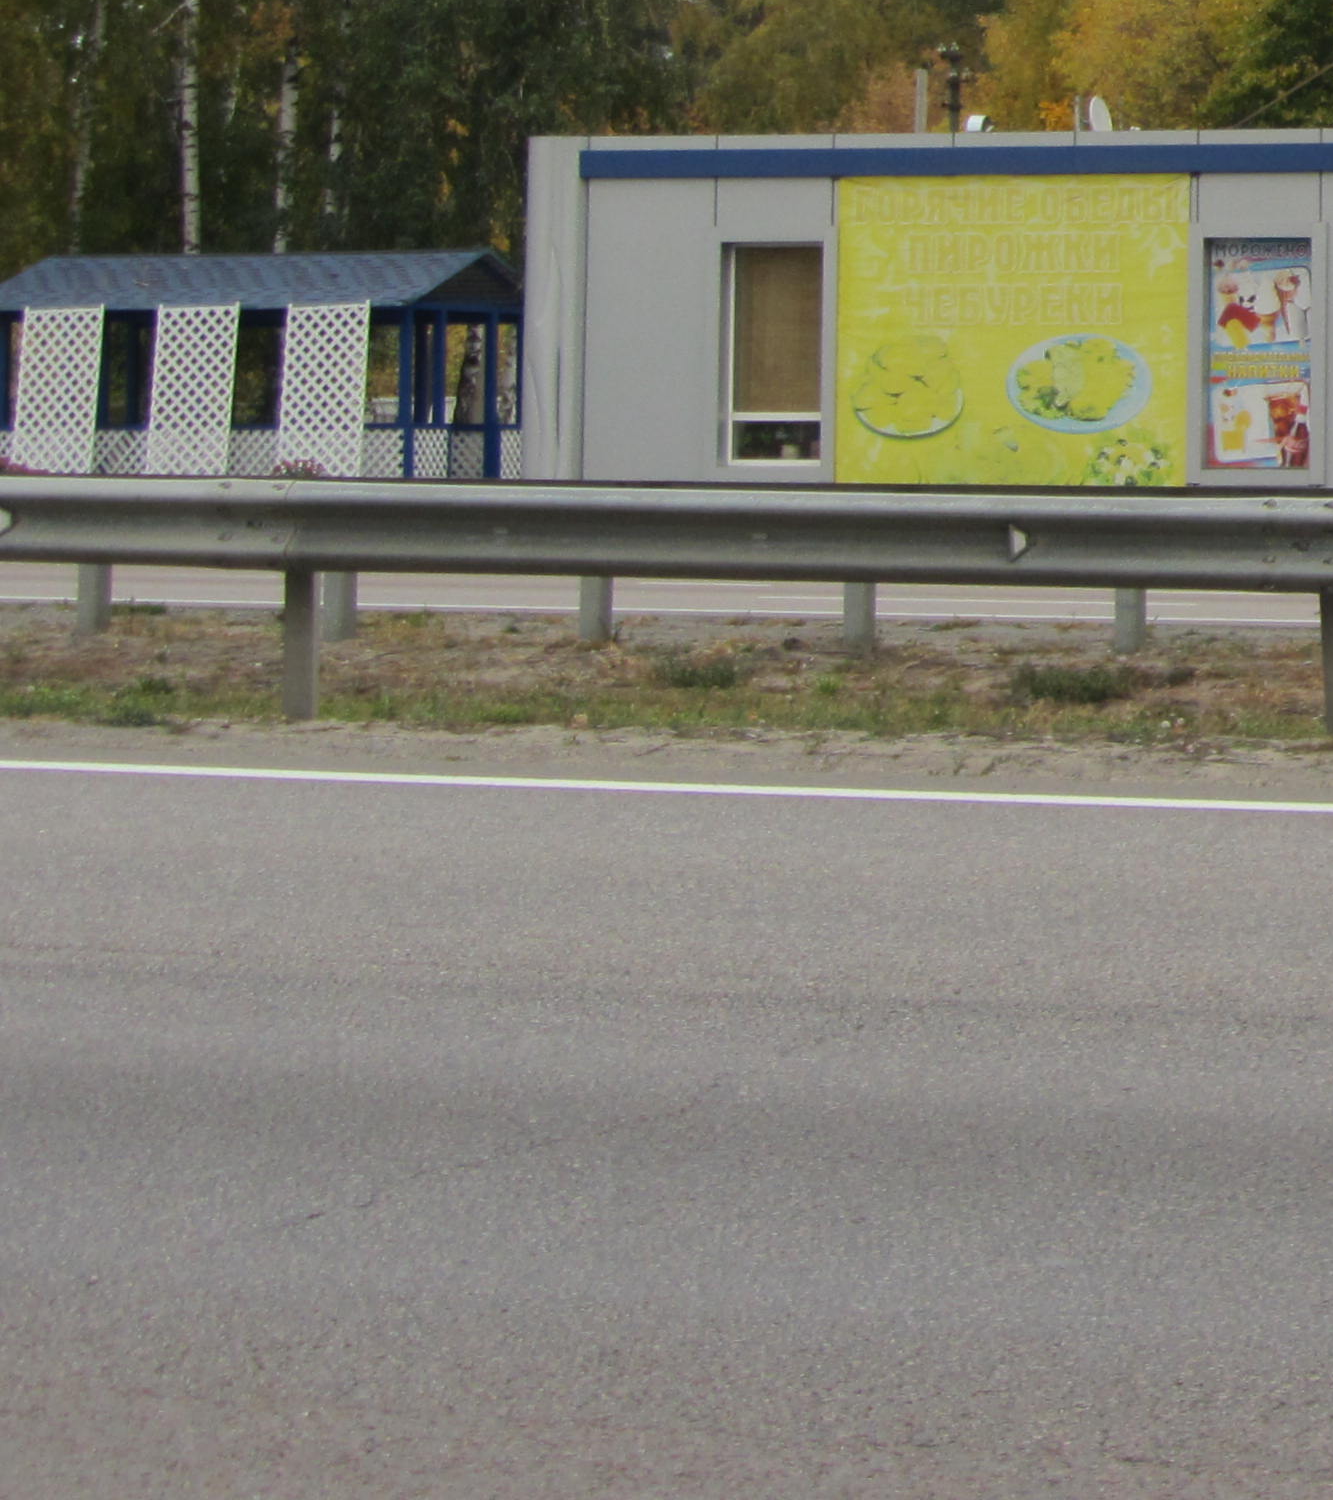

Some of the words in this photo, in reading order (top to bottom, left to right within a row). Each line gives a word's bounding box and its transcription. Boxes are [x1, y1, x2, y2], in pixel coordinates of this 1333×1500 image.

[854, 186, 1027, 225] ГОРЯЧИЕ
[1036, 185, 1187, 225] ОБЕДЫ
[906, 232, 1121, 273] ПИРОЖКИ
[1214, 243, 1306, 257] МОРОЖЕНО
[904, 283, 1123, 325] ЧЕБУРЕКИ
